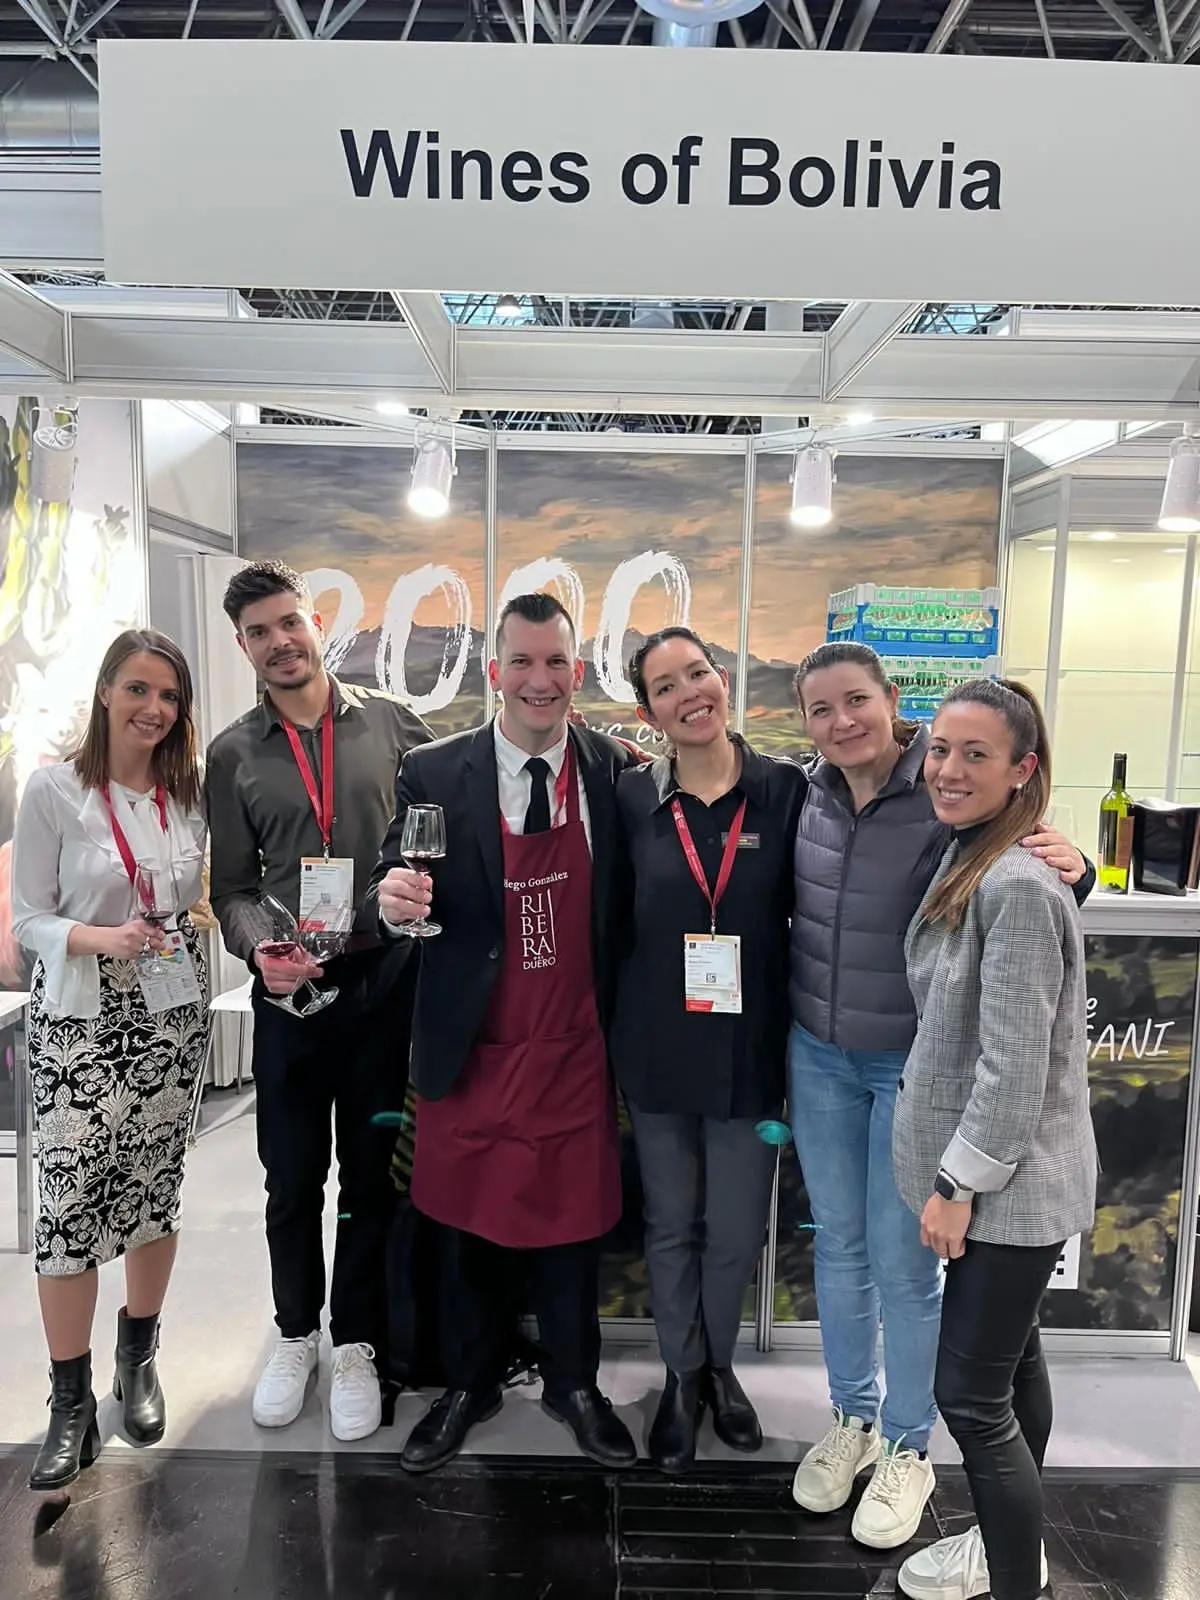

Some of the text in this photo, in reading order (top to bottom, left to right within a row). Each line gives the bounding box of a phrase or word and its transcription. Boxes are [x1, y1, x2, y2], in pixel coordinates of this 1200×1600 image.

[340, 128, 1002, 212] Wines of Bolivia
[503, 879, 526, 891] iego
[523, 957, 556, 970] DUERO
